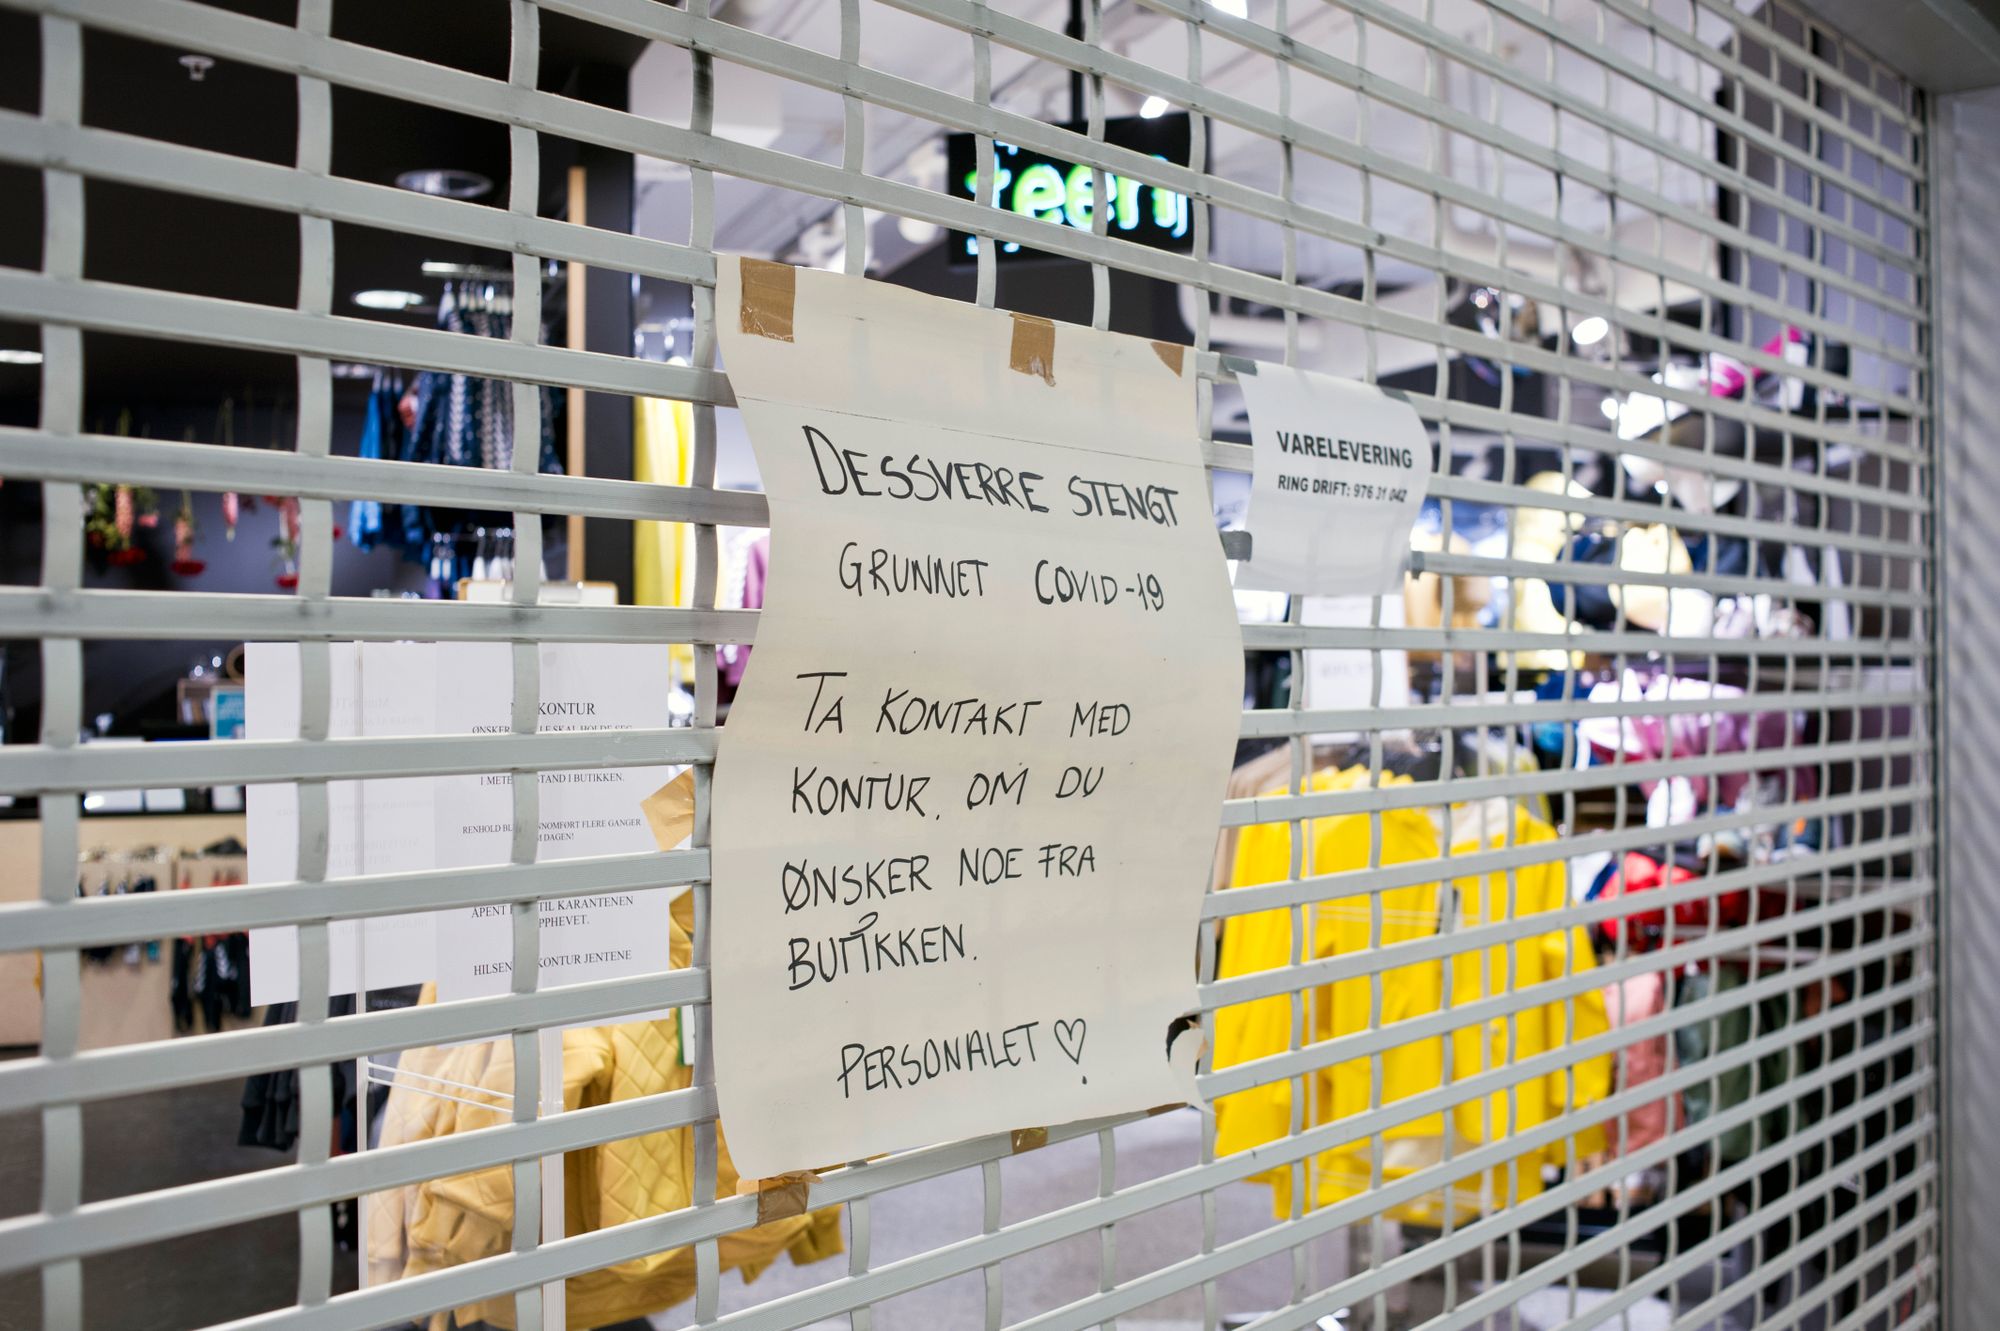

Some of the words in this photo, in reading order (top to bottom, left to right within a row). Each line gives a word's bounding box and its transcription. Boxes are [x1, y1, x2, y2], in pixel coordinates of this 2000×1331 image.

[1276, 430, 1413, 469] VARELEVERING
[802, 425, 1050, 513] DESSVERRE
[1068, 475, 1179, 527] STENGT
[1278, 475, 1308, 492] RING
[1312, 479, 1350, 497] DRIFT:
[1353, 484, 1373, 500] 976
[839, 542, 989, 598] GRUNNET
[1035, 559, 1164, 612] COVID-19
[538, 702, 595, 716] KONTUR
[796, 672, 848, 734] TA
[875, 688, 1043, 736] KONTAKT
[1070, 701, 1131, 738] MED
[486, 775, 513, 785] METE
[966, 768, 1030, 810] OM
[1055, 765, 1104, 799] DU
[462, 825, 502, 834] RENHOLD
[582, 819, 608, 828] FLERE
[608, 818, 641, 828] GANGER
[782, 855, 932, 914] ØNSKER
[960, 847, 1024, 886] NOE
[1038, 843, 1096, 878] FRA
[538, 914, 590, 928] PPHEVET.
[558, 896, 634, 911] KARANTENEN
[473, 960, 513, 976] HILSEN
[583, 949, 633, 964] JENTENE
[788, 911, 978, 991] BUTIKKEN.
[837, 1021, 1040, 1098] PERSONALET
